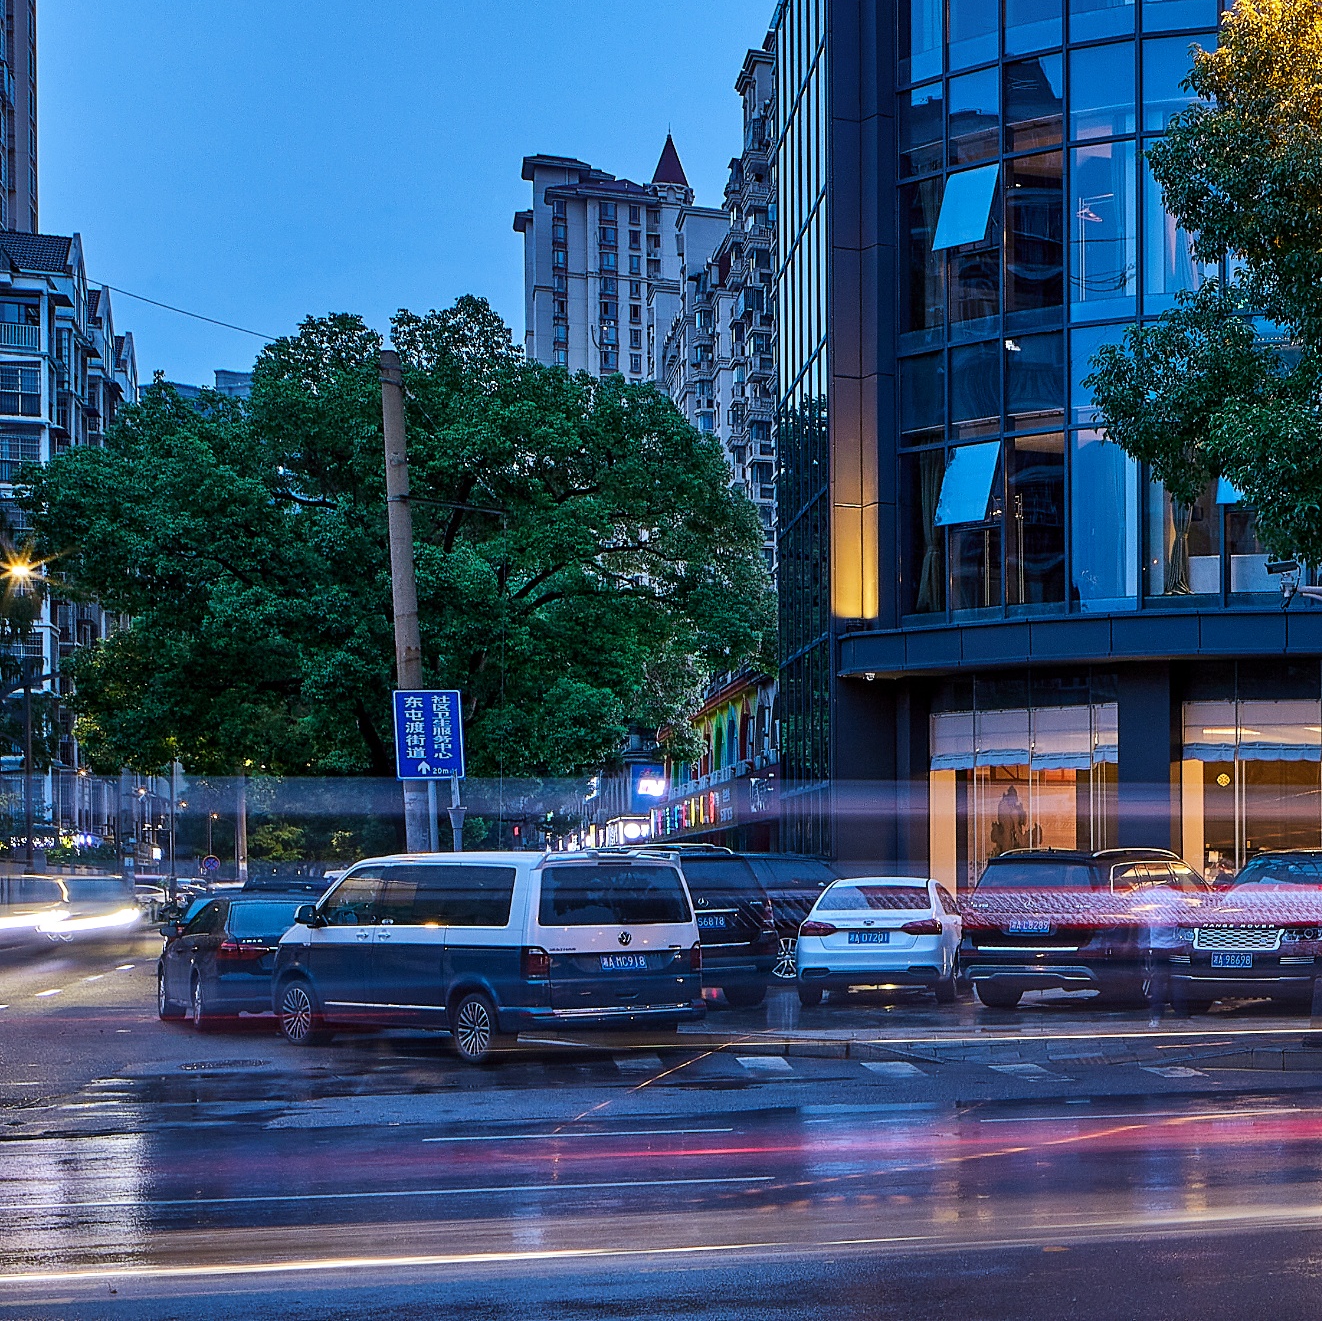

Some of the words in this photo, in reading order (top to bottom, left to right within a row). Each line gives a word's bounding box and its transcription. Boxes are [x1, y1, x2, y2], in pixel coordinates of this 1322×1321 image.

[403, 696, 427, 759] 东屯渡街道
[430, 695, 453, 759] 社区卫生服务中心
